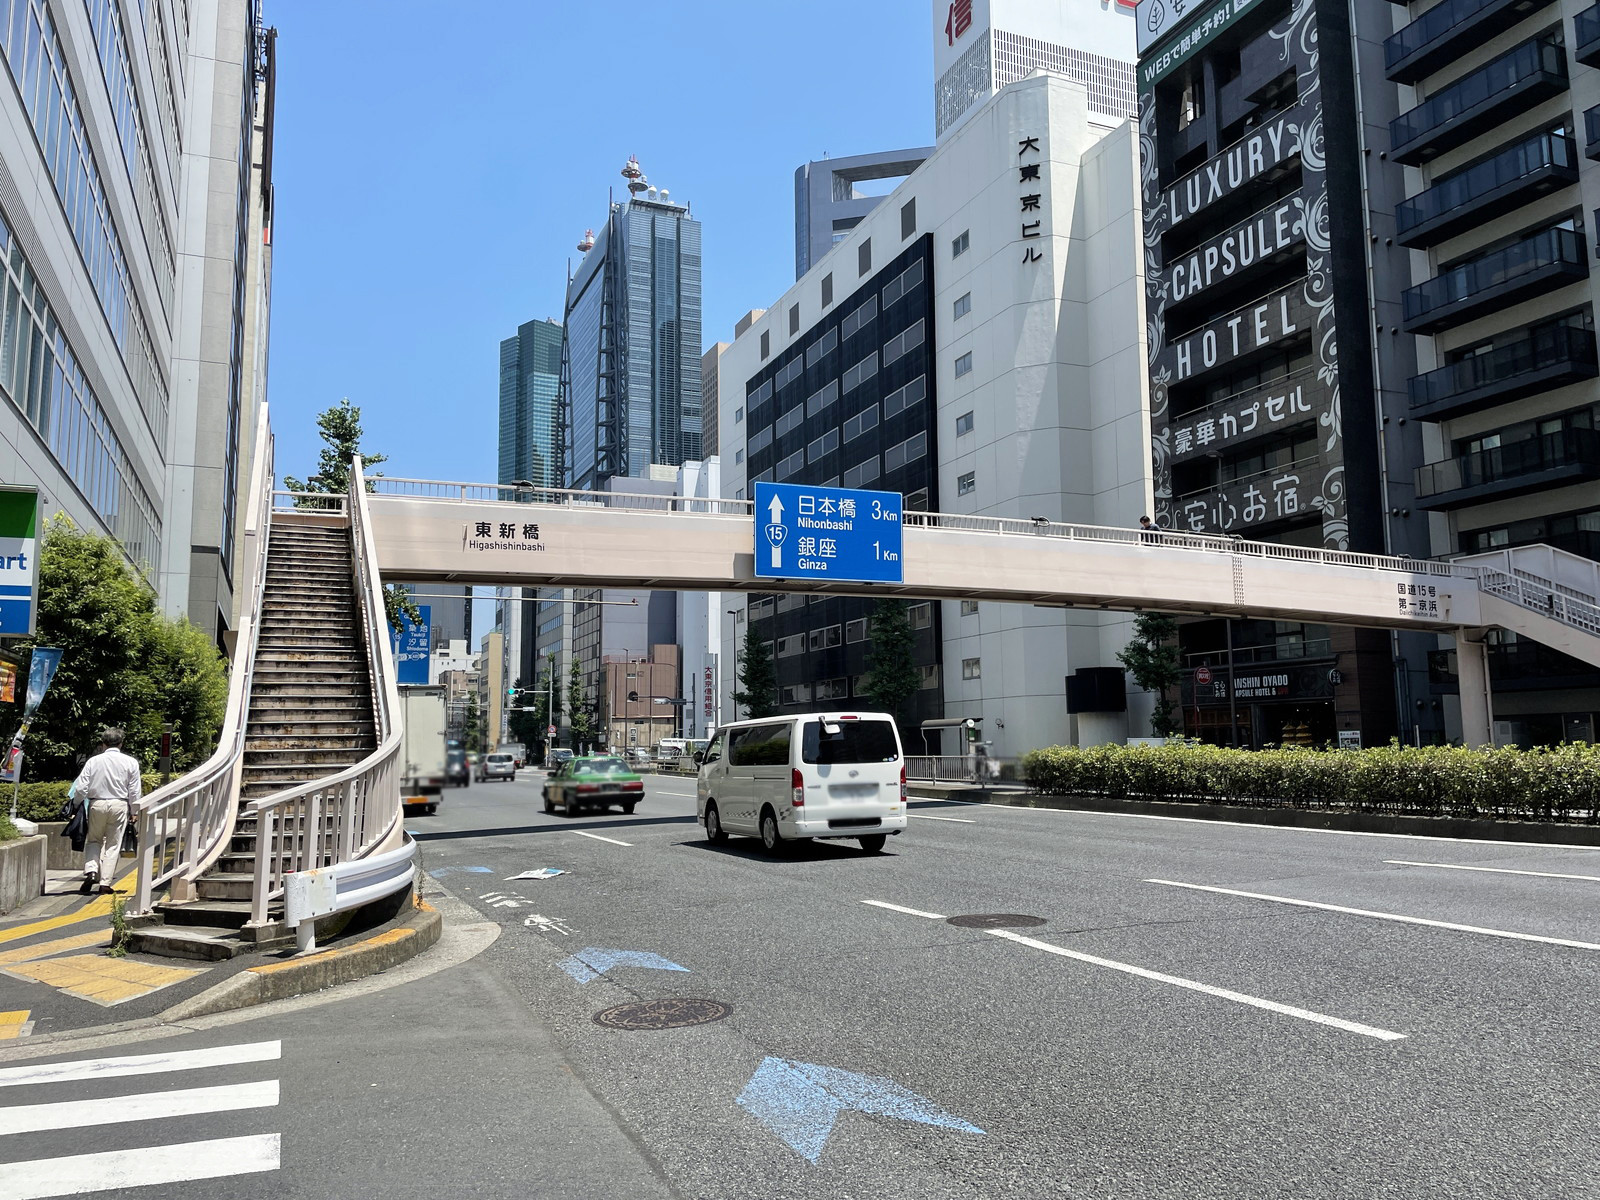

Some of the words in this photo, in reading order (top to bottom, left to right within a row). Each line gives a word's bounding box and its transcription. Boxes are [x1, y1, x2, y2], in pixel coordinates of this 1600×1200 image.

[1170, 119, 1285, 226] LUXURY
[1018, 136, 1043, 264] 大東京ビル
[1172, 205, 1291, 302] CAPSULE
[1176, 294, 1296, 380] HOTEL
[1174, 386, 1312, 455] 豪華カプセル
[798, 495, 857, 519] 日本橋
[871, 499, 881, 520] 3
[883, 510, 898, 521] Km
[1184, 474, 1301, 533] 安心お宿
[475, 521, 540, 540] 東新橋
[769, 526, 783, 540] 15
[797, 517, 853, 531] Nihonbashi
[469, 540, 545, 552] Higashishinbashi
[797, 536, 837, 558] 銀座
[873, 541, 880, 560] 1
[883, 550, 898, 561] Km
[797, 558, 828, 570] Ginza
[1397, 583, 1437, 598] 国道15号
[1398, 597, 1438, 612] 第一京浜
[1262, 674, 1289, 687] OYADO
[704, 666, 713, 718] 大東京信用組合
[1255, 688, 1271, 697] HOTEL
